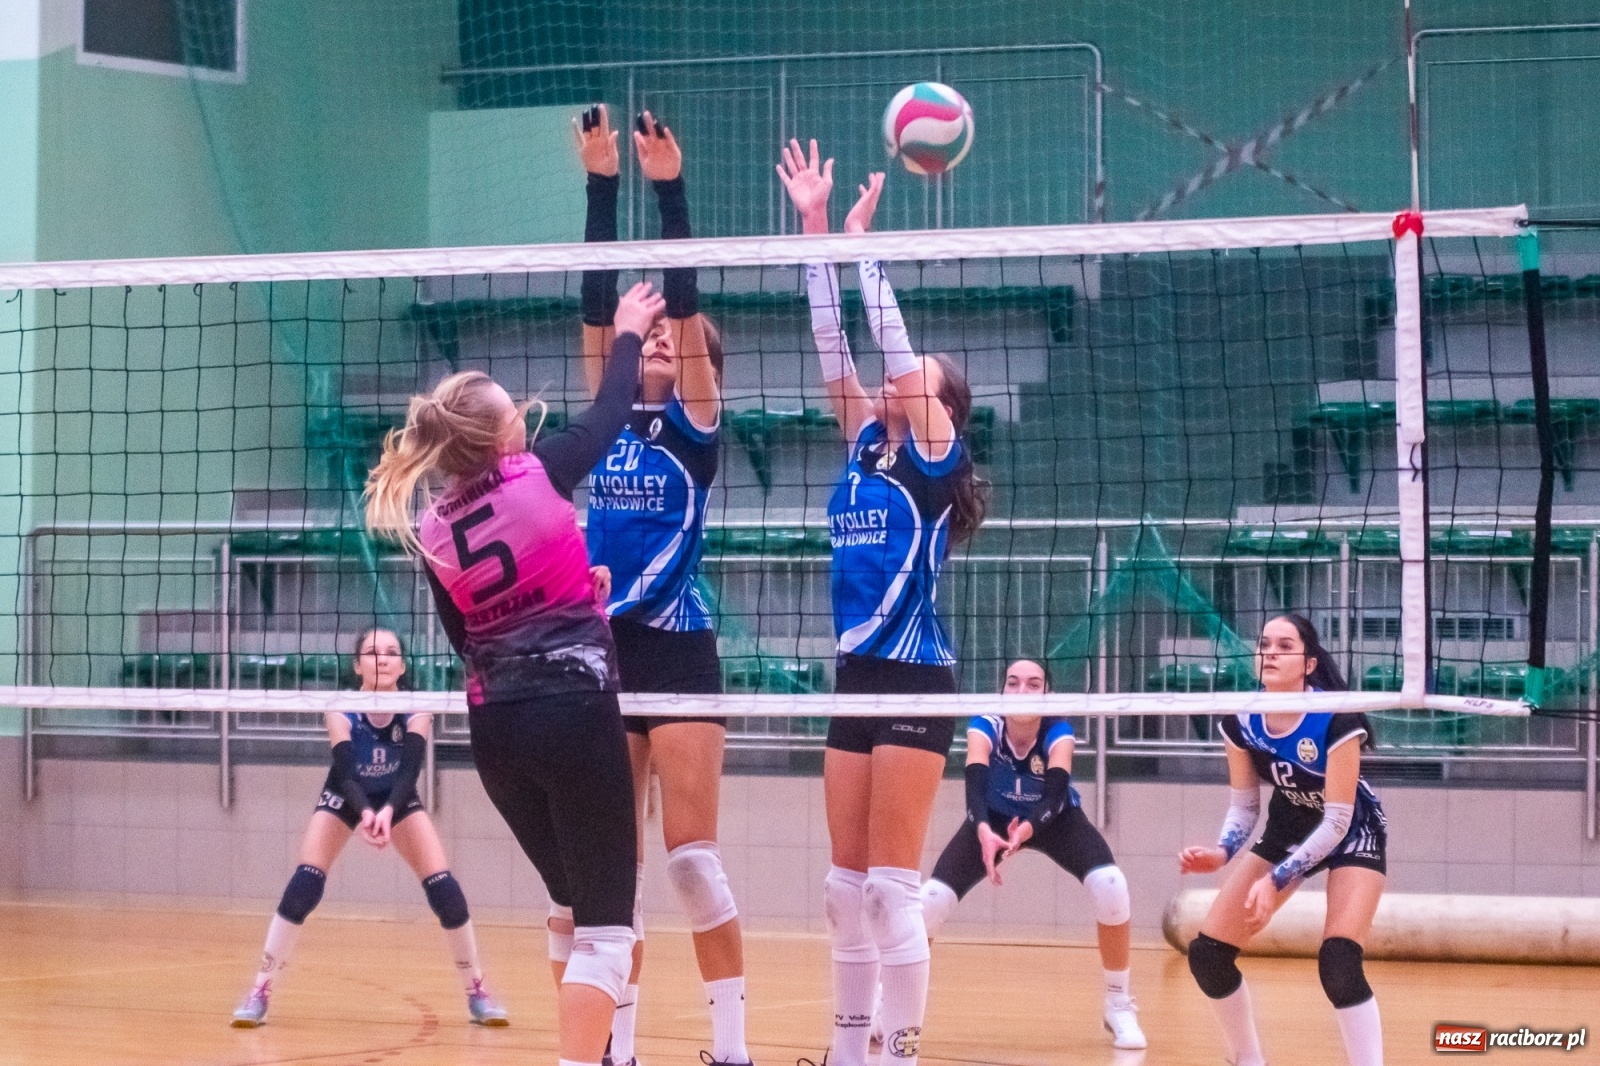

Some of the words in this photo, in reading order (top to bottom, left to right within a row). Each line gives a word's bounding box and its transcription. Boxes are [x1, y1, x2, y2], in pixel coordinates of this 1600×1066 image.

[606, 438, 644, 471] 20
[600, 475, 667, 495] VOLLEY
[836, 508, 888, 532] VOLLEY
[451, 503, 517, 605] 5
[1271, 761, 1297, 788] 12
